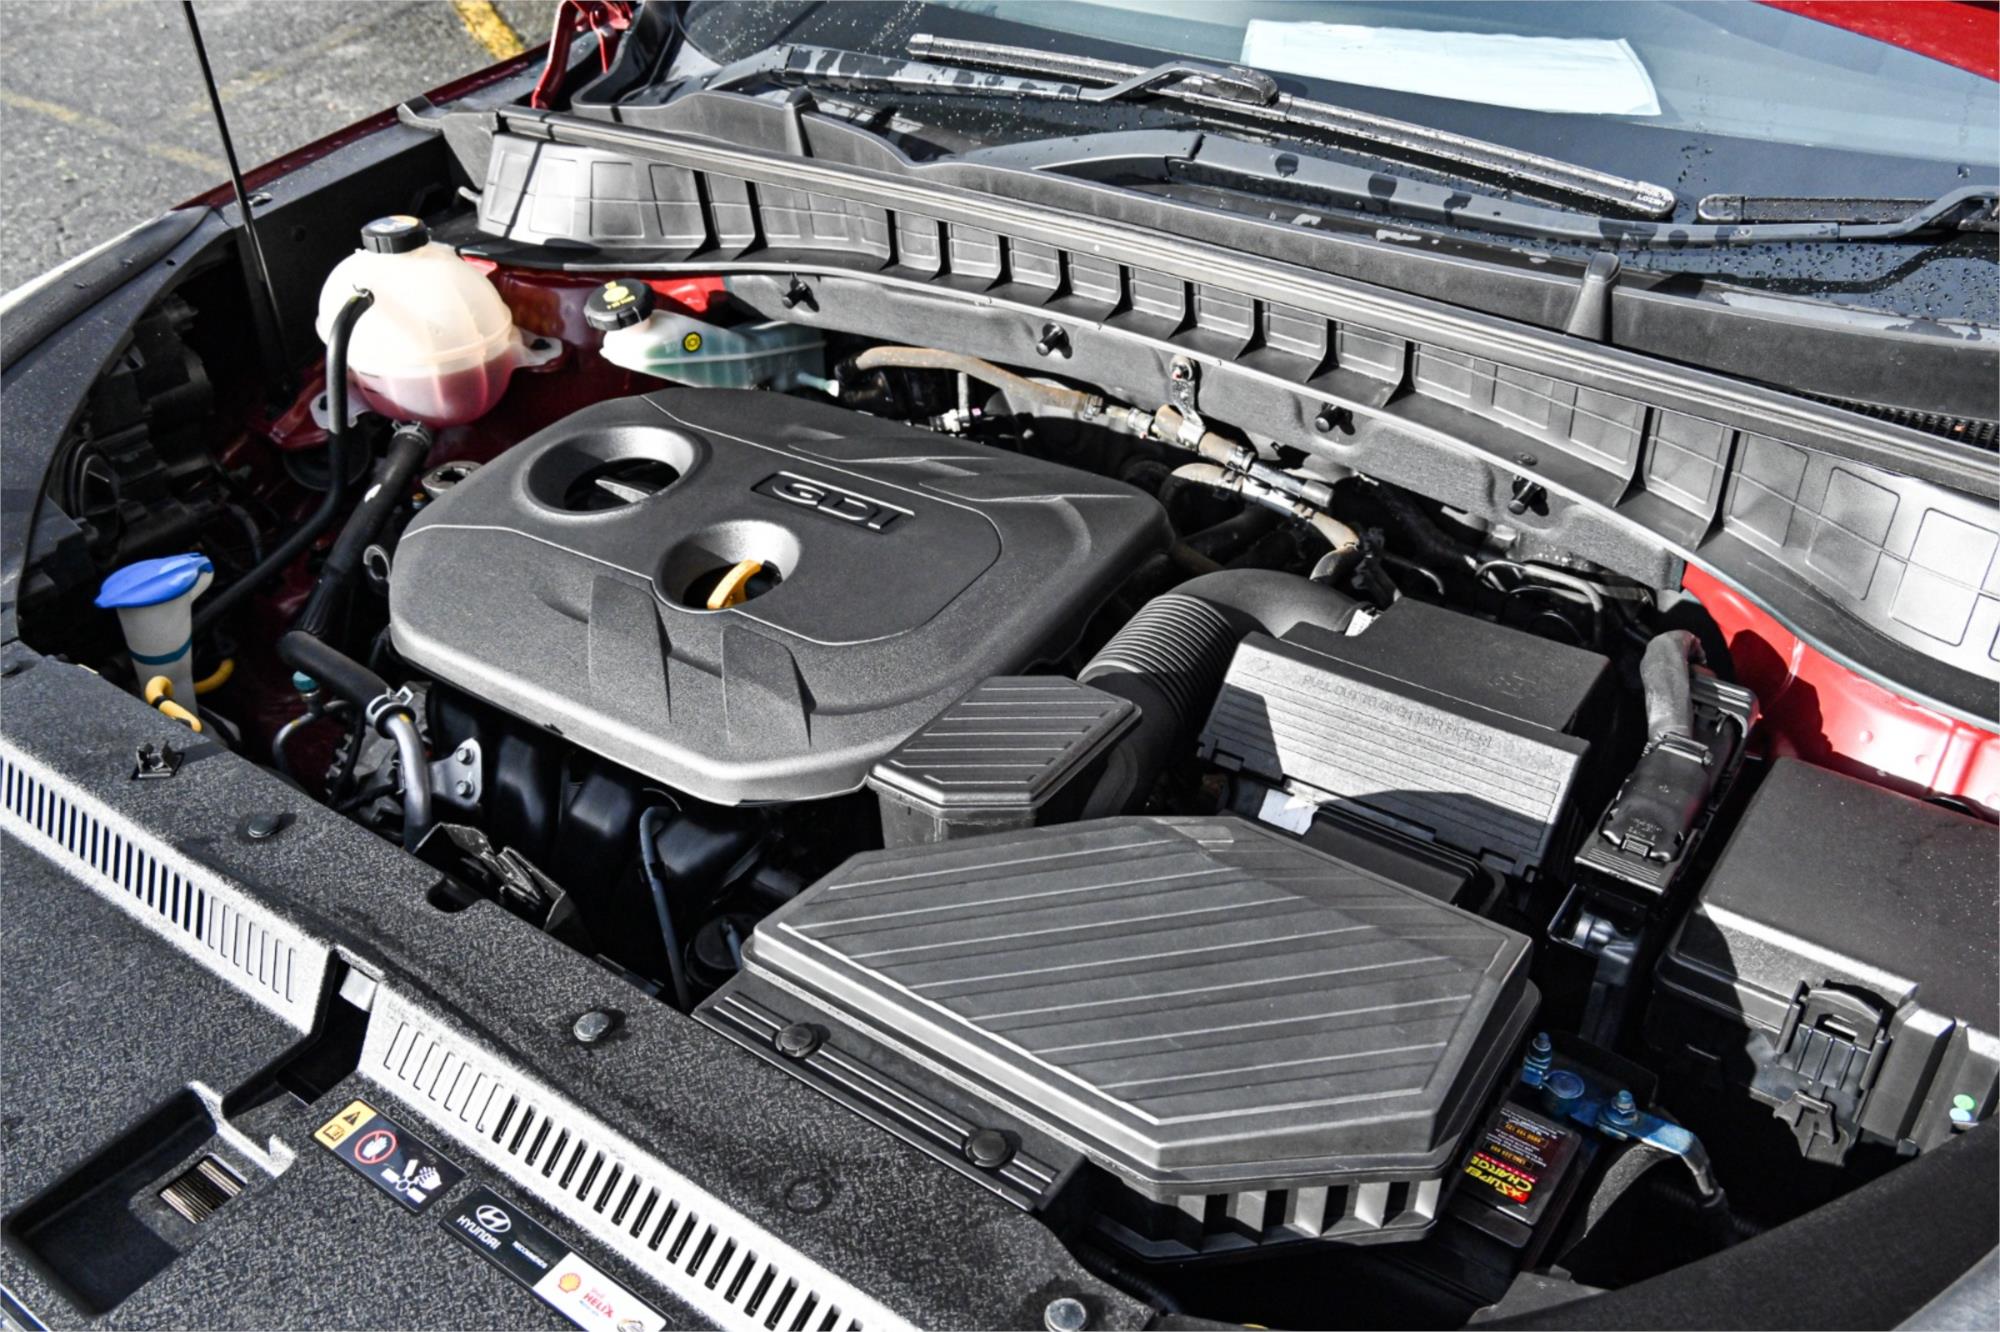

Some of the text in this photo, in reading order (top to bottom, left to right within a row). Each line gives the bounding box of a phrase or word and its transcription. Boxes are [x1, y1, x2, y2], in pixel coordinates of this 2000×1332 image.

[771, 482, 903, 531] GDI
[1470, 1155, 1533, 1192] CHARGE
[456, 1215, 502, 1250] HYUNDAI
[583, 1292, 614, 1319] HELIX
